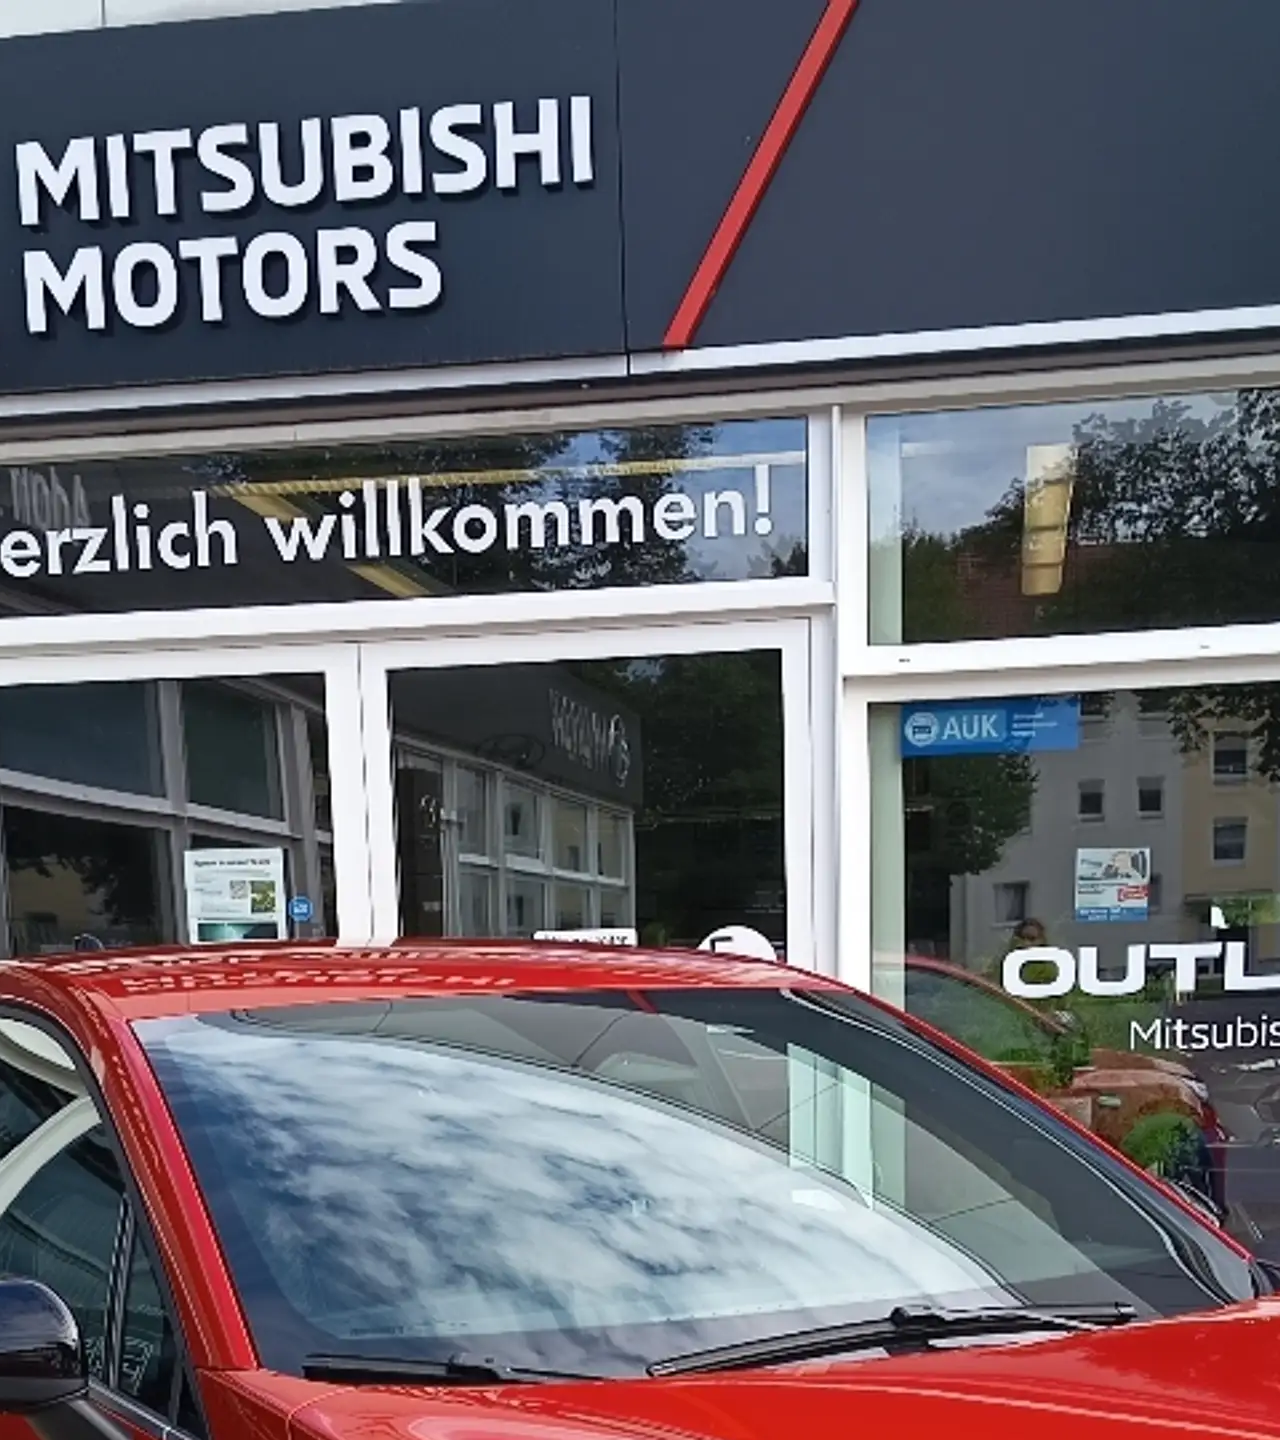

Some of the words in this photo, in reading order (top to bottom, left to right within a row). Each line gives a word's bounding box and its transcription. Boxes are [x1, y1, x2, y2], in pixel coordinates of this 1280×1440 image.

[14, 96, 595, 226] MITSUBISHI
[22, 220, 443, 332] MOTORS
[264, 462, 773, 563] willkommen!
[941, 714, 999, 740] AUK
